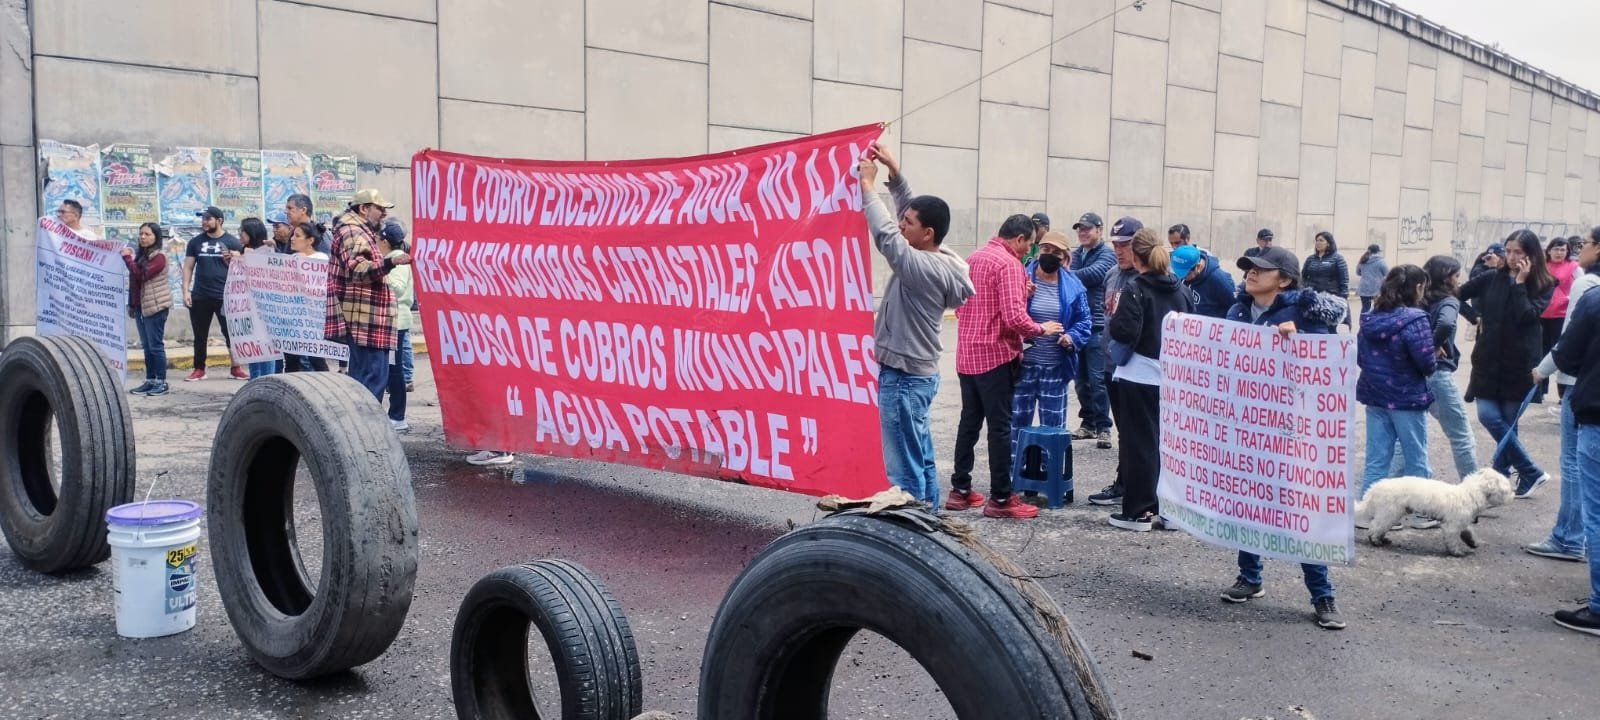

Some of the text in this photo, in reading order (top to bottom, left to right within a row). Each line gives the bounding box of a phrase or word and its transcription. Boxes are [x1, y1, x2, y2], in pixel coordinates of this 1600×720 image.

[415, 160, 440, 220] NO
[443, 162, 467, 222] AL
[473, 164, 540, 226] COBRO
[531, 171, 650, 227] EXCESIVOS
[643, 171, 684, 225] DE
[677, 162, 759, 239] AGUA,
[758, 151, 800, 220] NO
[414, 236, 874, 327] RECLASIFICADORAS CATRASTALES, ALTO AL
[437, 310, 879, 407] ABUSO DE COBROS MUNICIPALES
[1163, 337, 1348, 386] DESCARGA DE AGUAS NEGRAS Y
[1165, 319, 1176, 333] LA
[1183, 318, 1203, 337] RED
[1209, 322, 1224, 342] DE
[1230, 327, 1262, 349] AGUA
[1340, 340, 1348, 359] Y
[1162, 360, 1210, 389] PLUVIALES
[1217, 374, 1230, 393] EN
[1237, 378, 1294, 406] MISIONES
[1317, 393, 1346, 412] SON
[1162, 385, 1176, 405] UNA
[1241, 405, 1293, 431] ADEMAS
[1297, 416, 1311, 436] DE
[1316, 420, 1346, 439] QUE
[534, 388, 630, 453] AGUA
[621, 403, 795, 480] POTABLE
[1173, 412, 1208, 437] PLANTA
[1214, 423, 1229, 443] DE
[1235, 427, 1317, 462] TRATAMIENTO
[1327, 445, 1346, 464] DE
[1162, 451, 1345, 514] TODOS LOS DESECHOS ESTAN EN
[1190, 440, 1253, 473] RESIDUALES
[1257, 457, 1275, 478] NO
[1279, 462, 1346, 489] FUNCIONA
[1186, 484, 1309, 533] EL FRACCIONAMIENTO
[170, 549, 184, 563] 25
[1217, 521, 1238, 541] CON
[1240, 526, 1260, 548] SUS
[1263, 532, 1346, 561] OBLIGACIONES
